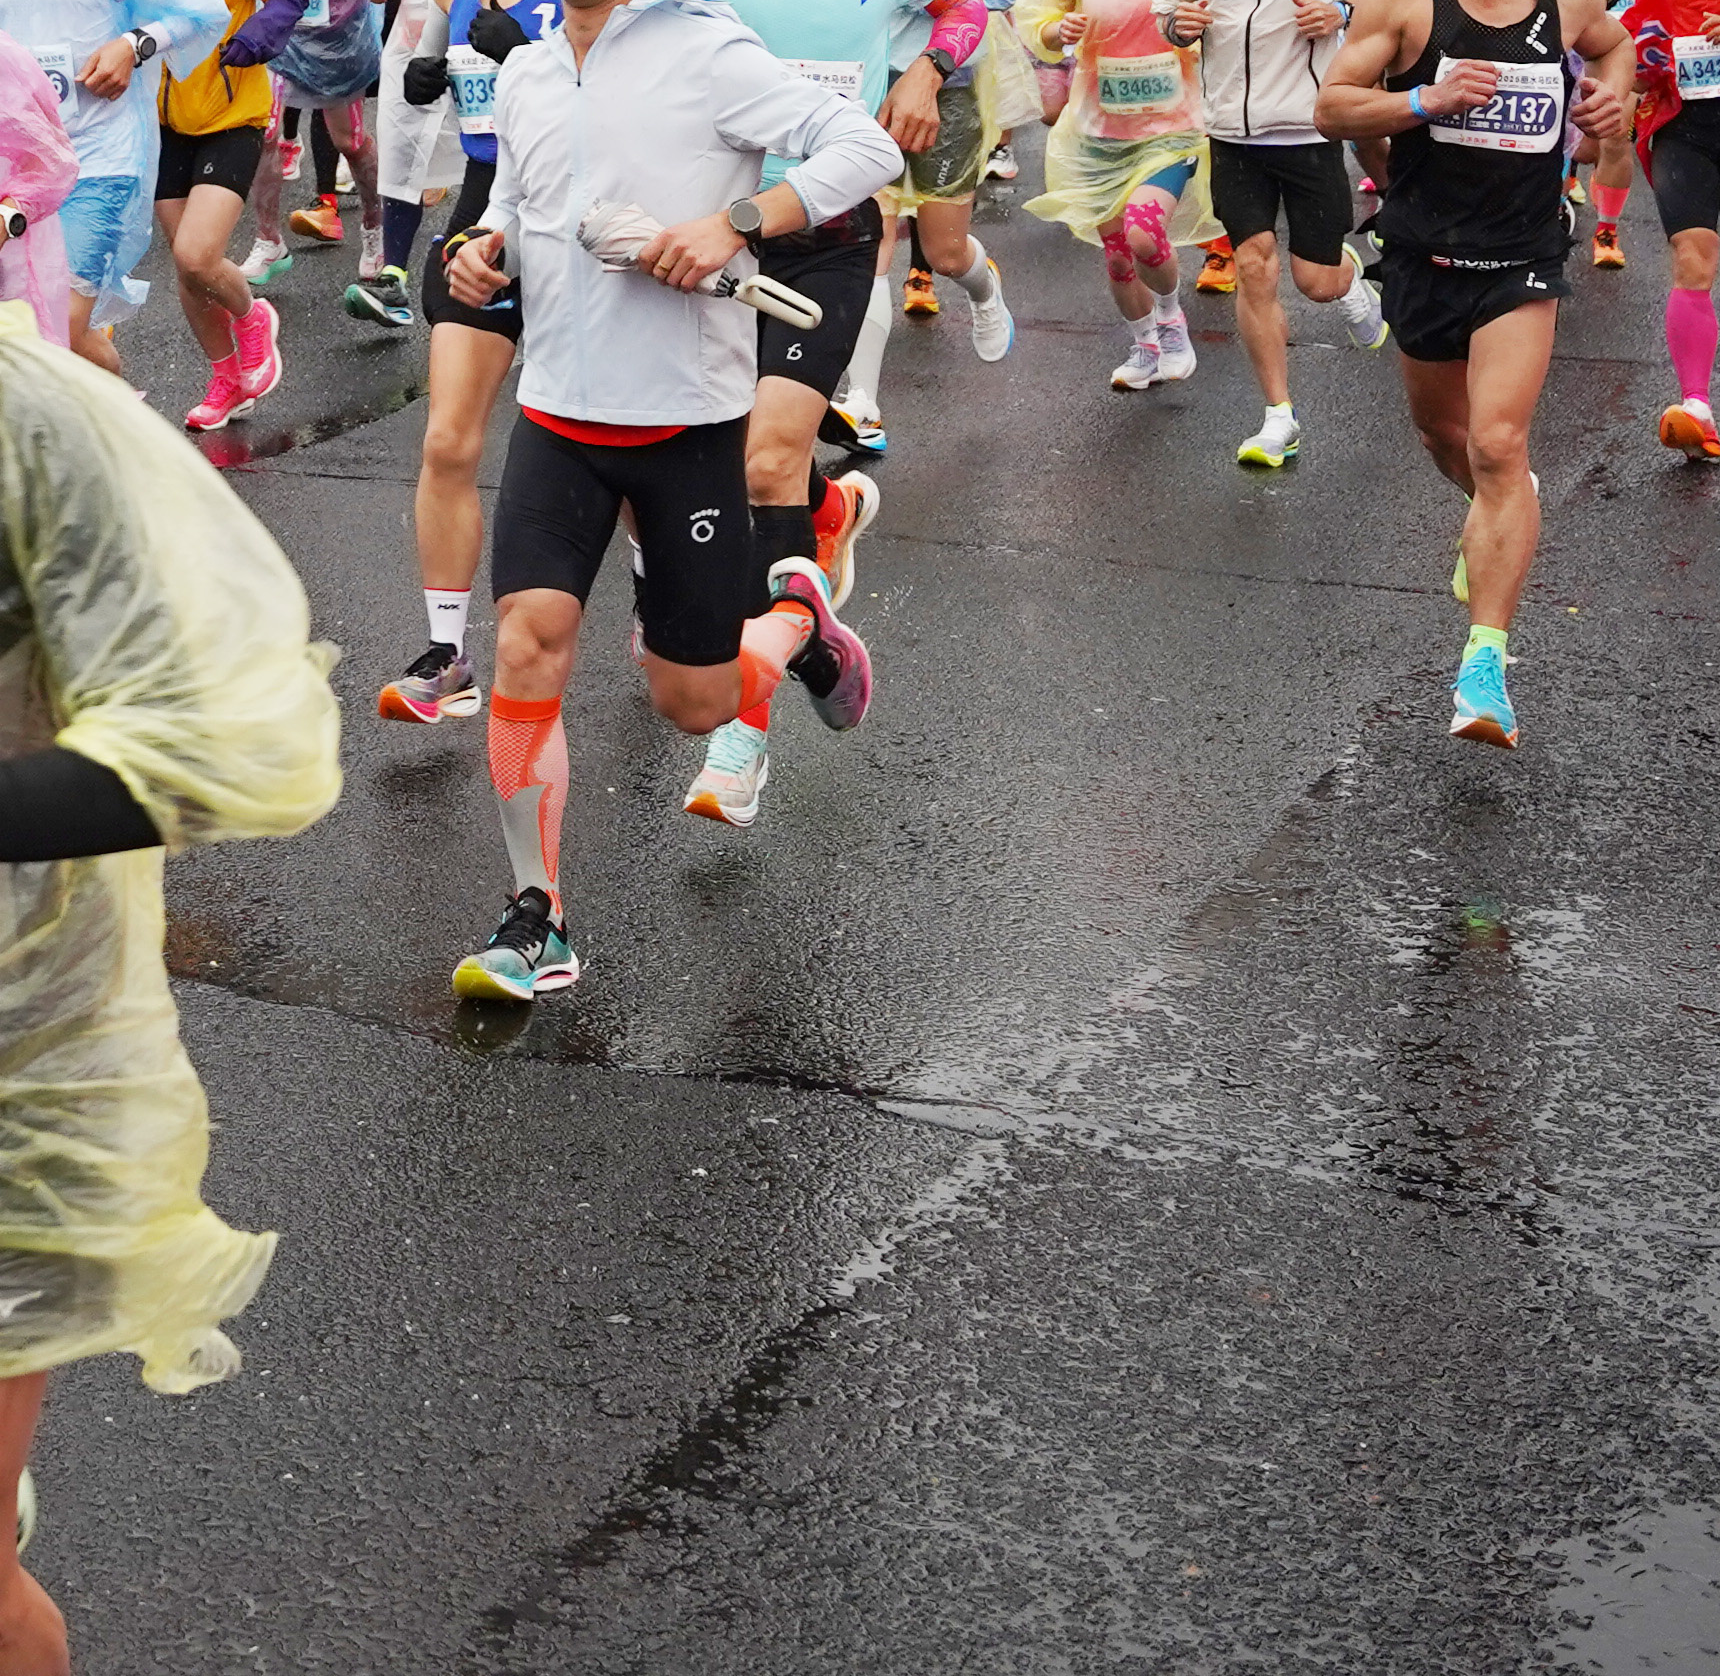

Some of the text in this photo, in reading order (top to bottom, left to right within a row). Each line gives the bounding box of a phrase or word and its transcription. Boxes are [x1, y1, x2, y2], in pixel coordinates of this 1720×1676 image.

[1679, 62, 1691, 83] A
[1101, 79, 1115, 98] A
[1469, 95, 1553, 124] 22137
